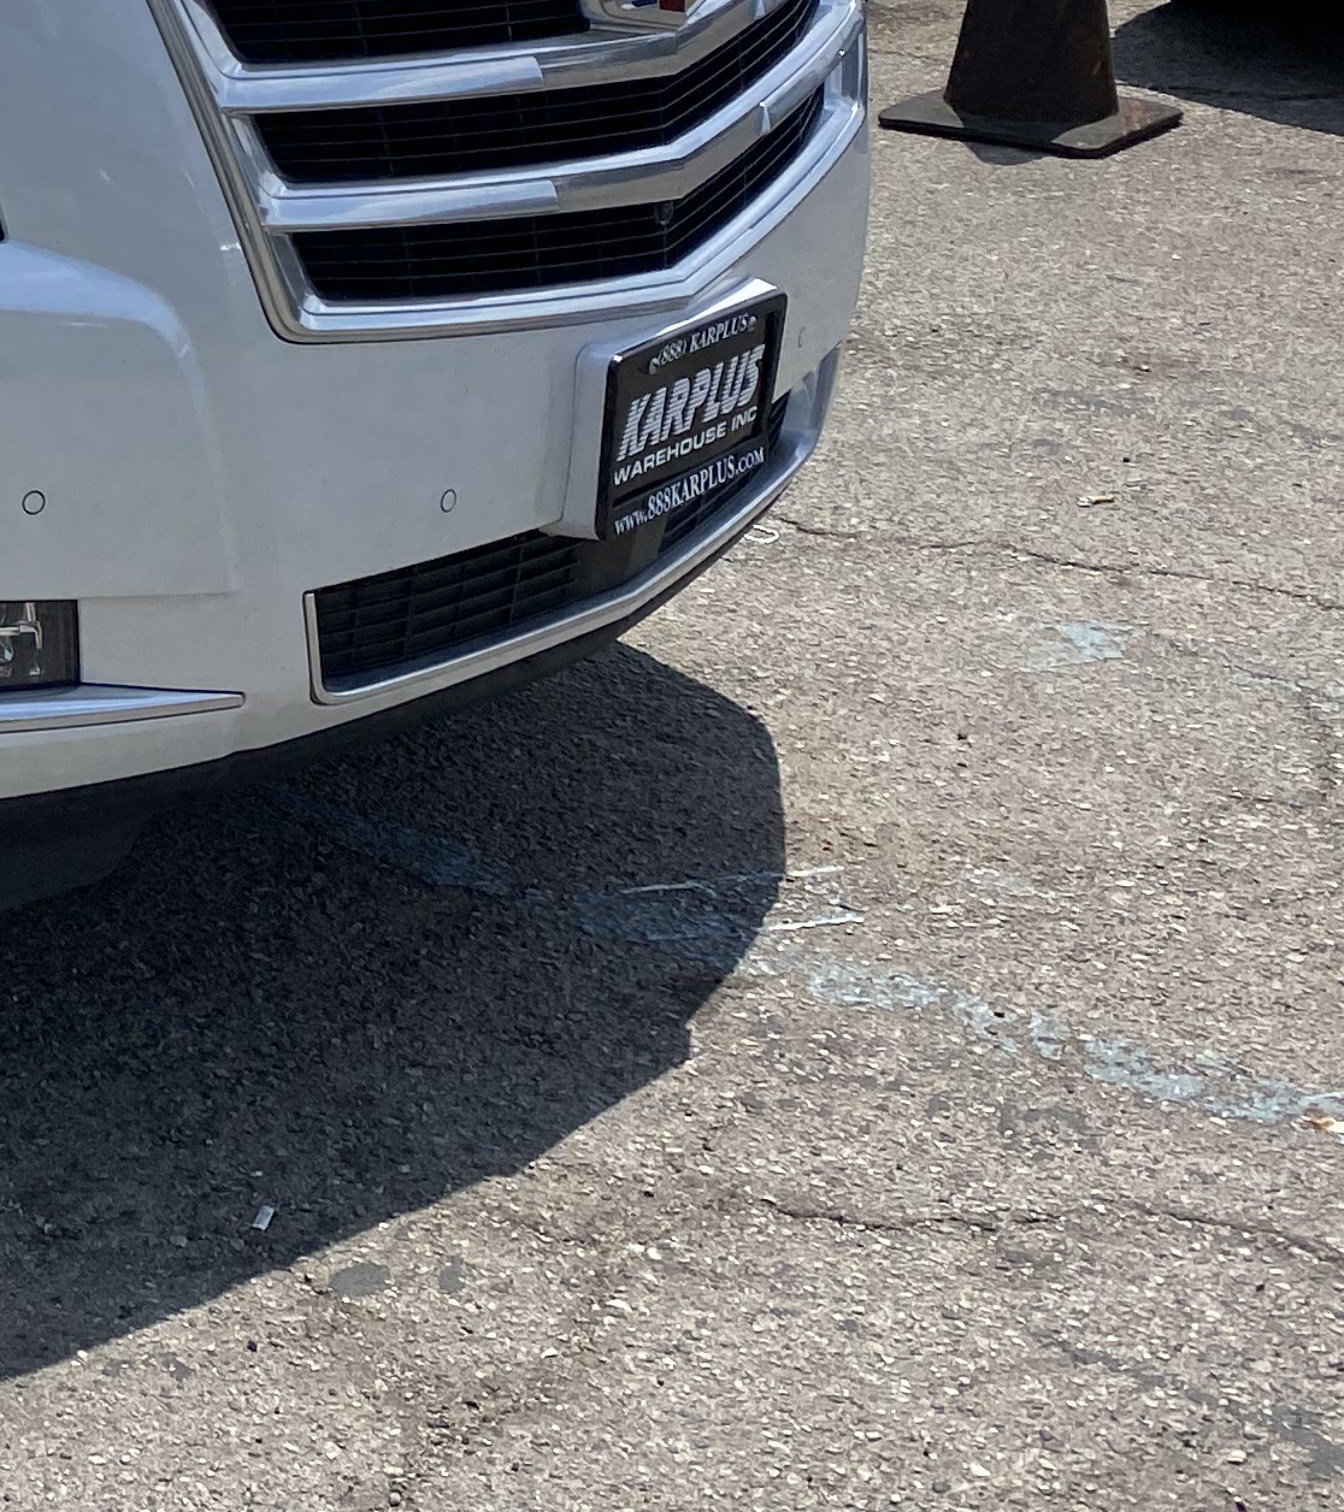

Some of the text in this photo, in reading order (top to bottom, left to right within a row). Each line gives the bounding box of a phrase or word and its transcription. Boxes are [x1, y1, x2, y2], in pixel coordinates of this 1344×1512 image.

[689, 313, 749, 353] KARPLUS
[616, 344, 766, 462] KARPLUS
[614, 406, 758, 486] WAREHOUSE INC
